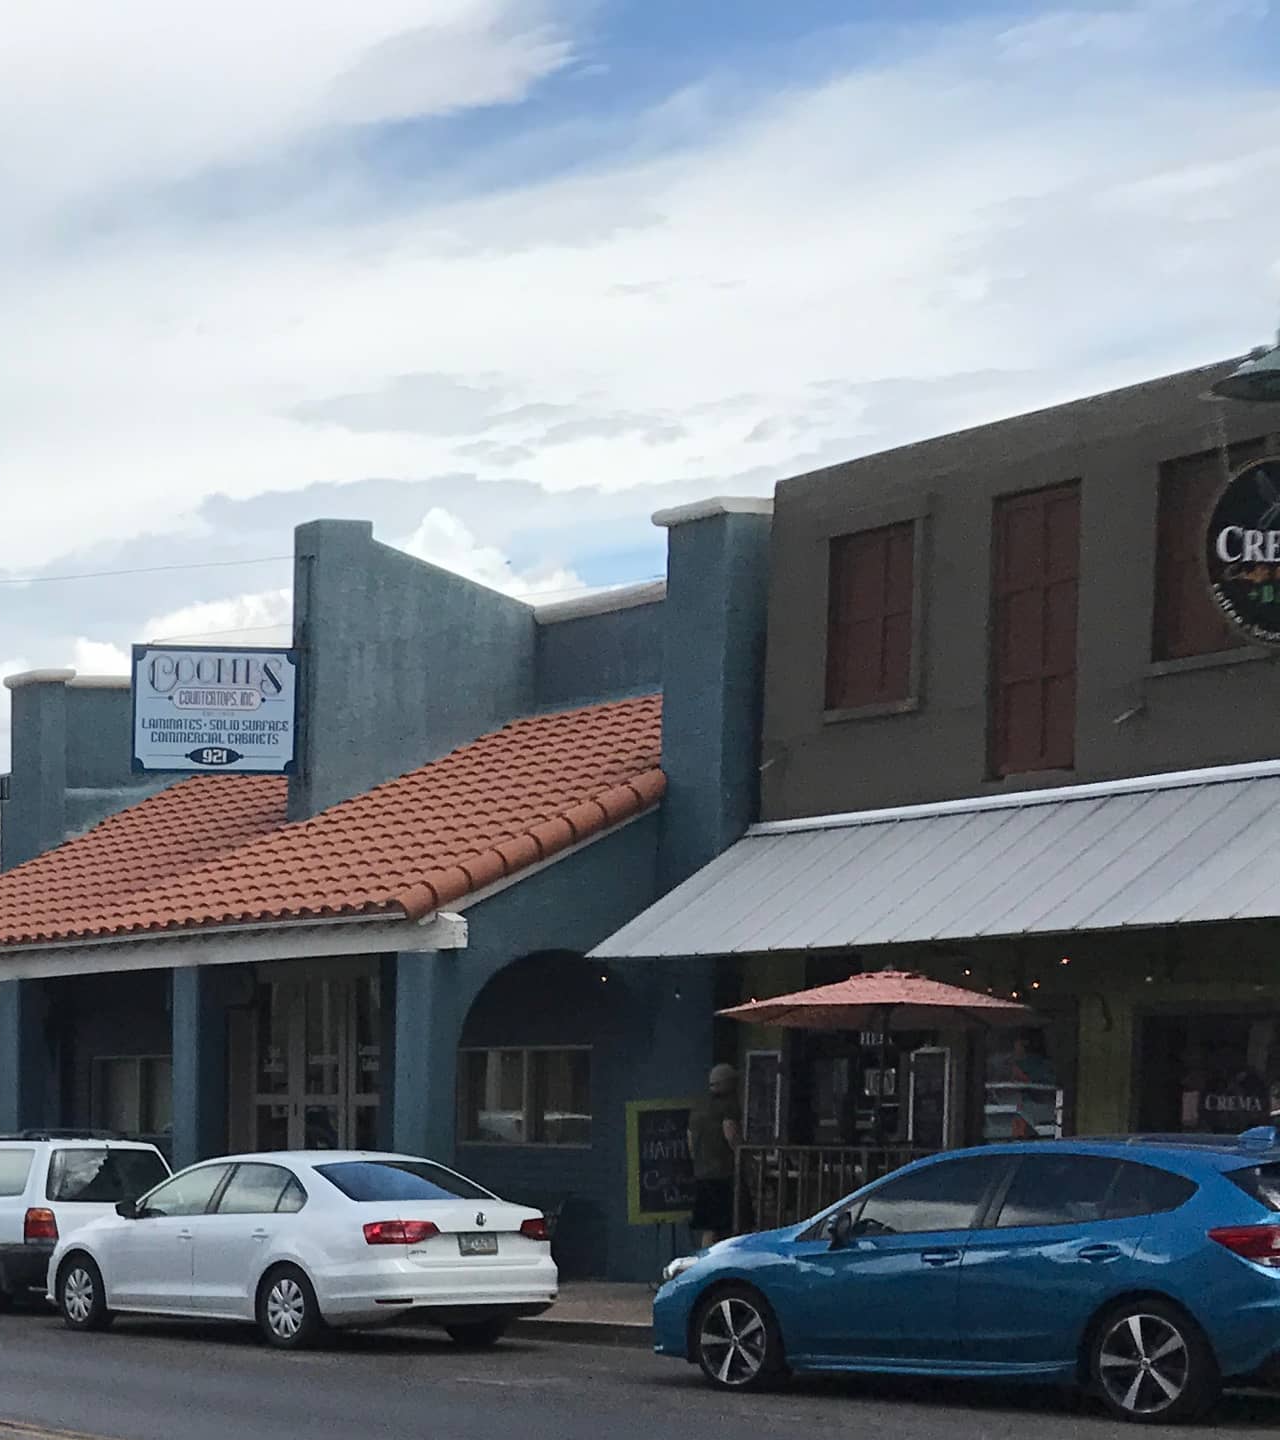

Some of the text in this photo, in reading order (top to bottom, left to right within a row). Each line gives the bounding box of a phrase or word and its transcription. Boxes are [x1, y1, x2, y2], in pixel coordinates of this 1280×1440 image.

[209, 719, 240, 731] SOLID
[241, 720, 289, 732] SURFACE
[151, 731, 280, 745] COMMERCIAL CABINETS
[202, 749, 228, 763] 921
[1204, 1094, 1263, 1112] CREMA
